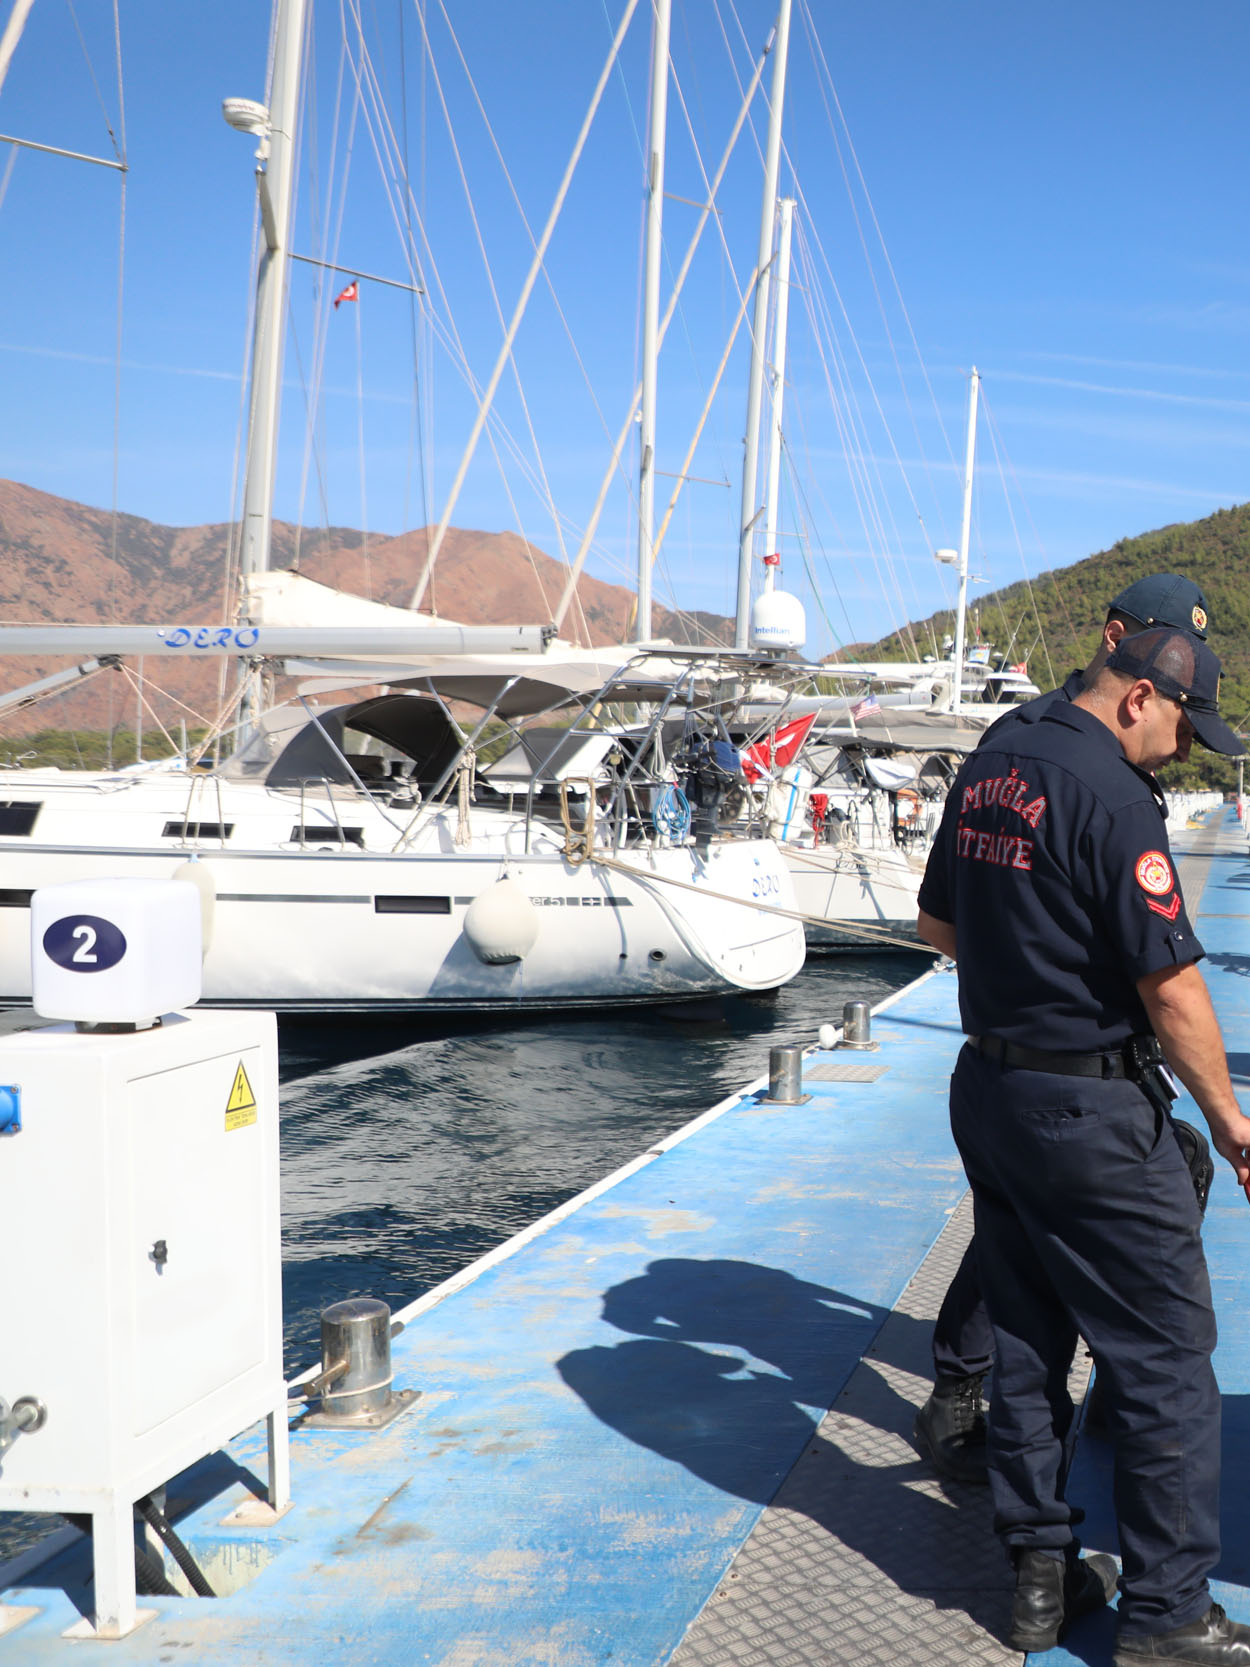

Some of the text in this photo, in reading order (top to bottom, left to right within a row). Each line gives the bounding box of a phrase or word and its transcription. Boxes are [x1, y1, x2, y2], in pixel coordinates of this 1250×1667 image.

[165, 628, 259, 649] DERO
[960, 768, 1048, 828] MUĞLA
[957, 819, 1034, 871] İTFAİYE
[72, 925, 98, 963] 2
